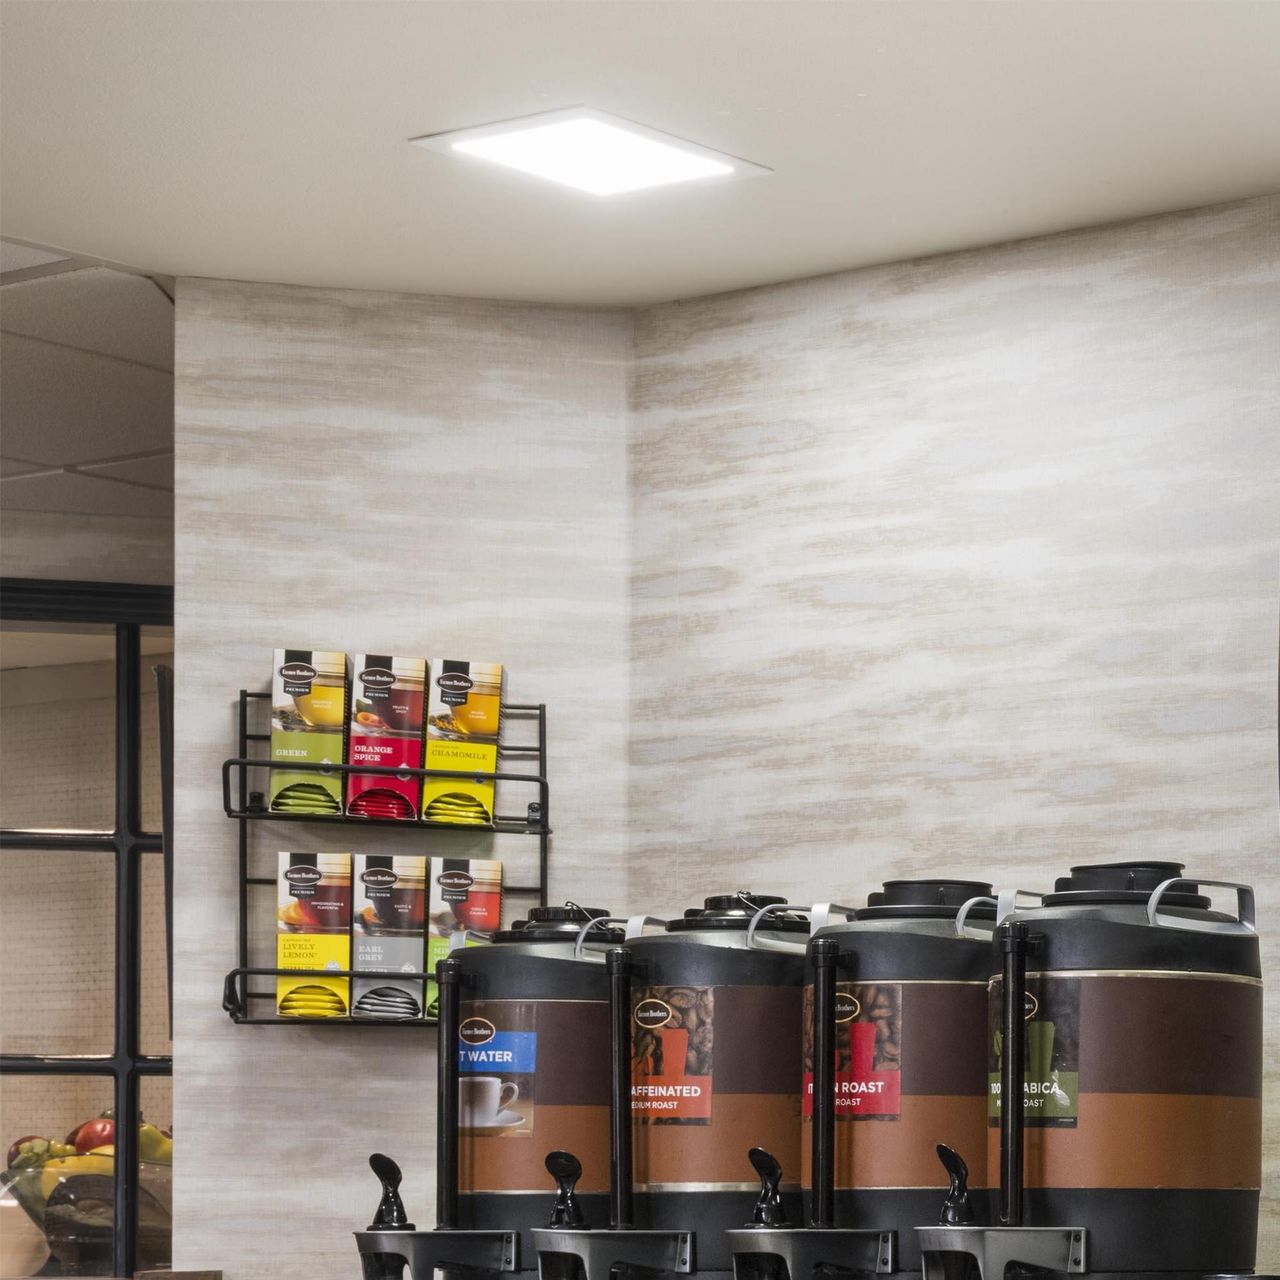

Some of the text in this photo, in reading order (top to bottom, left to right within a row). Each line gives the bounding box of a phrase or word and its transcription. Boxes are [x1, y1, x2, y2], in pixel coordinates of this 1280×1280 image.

[276, 748, 308, 757] GREEN
[354, 744, 393, 755] ORANGE
[353, 752, 381, 762] SPICE
[431, 749, 488, 761] CHAMOMILE
[282, 943, 316, 951] LIVELY
[358, 945, 384, 953] EARL
[649, 1009, 668, 1018] Brothers
[469, 1050, 513, 1063] WATER
[630, 1085, 702, 1097] AFFEINATED
[841, 1081, 885, 1094] ROAST
[1023, 1081, 1060, 1094] ABICA
[631, 1101, 678, 1109] EDIUM ROAST
[835, 1098, 862, 1107] ROAST
[1023, 1098, 1045, 1107] OAST
